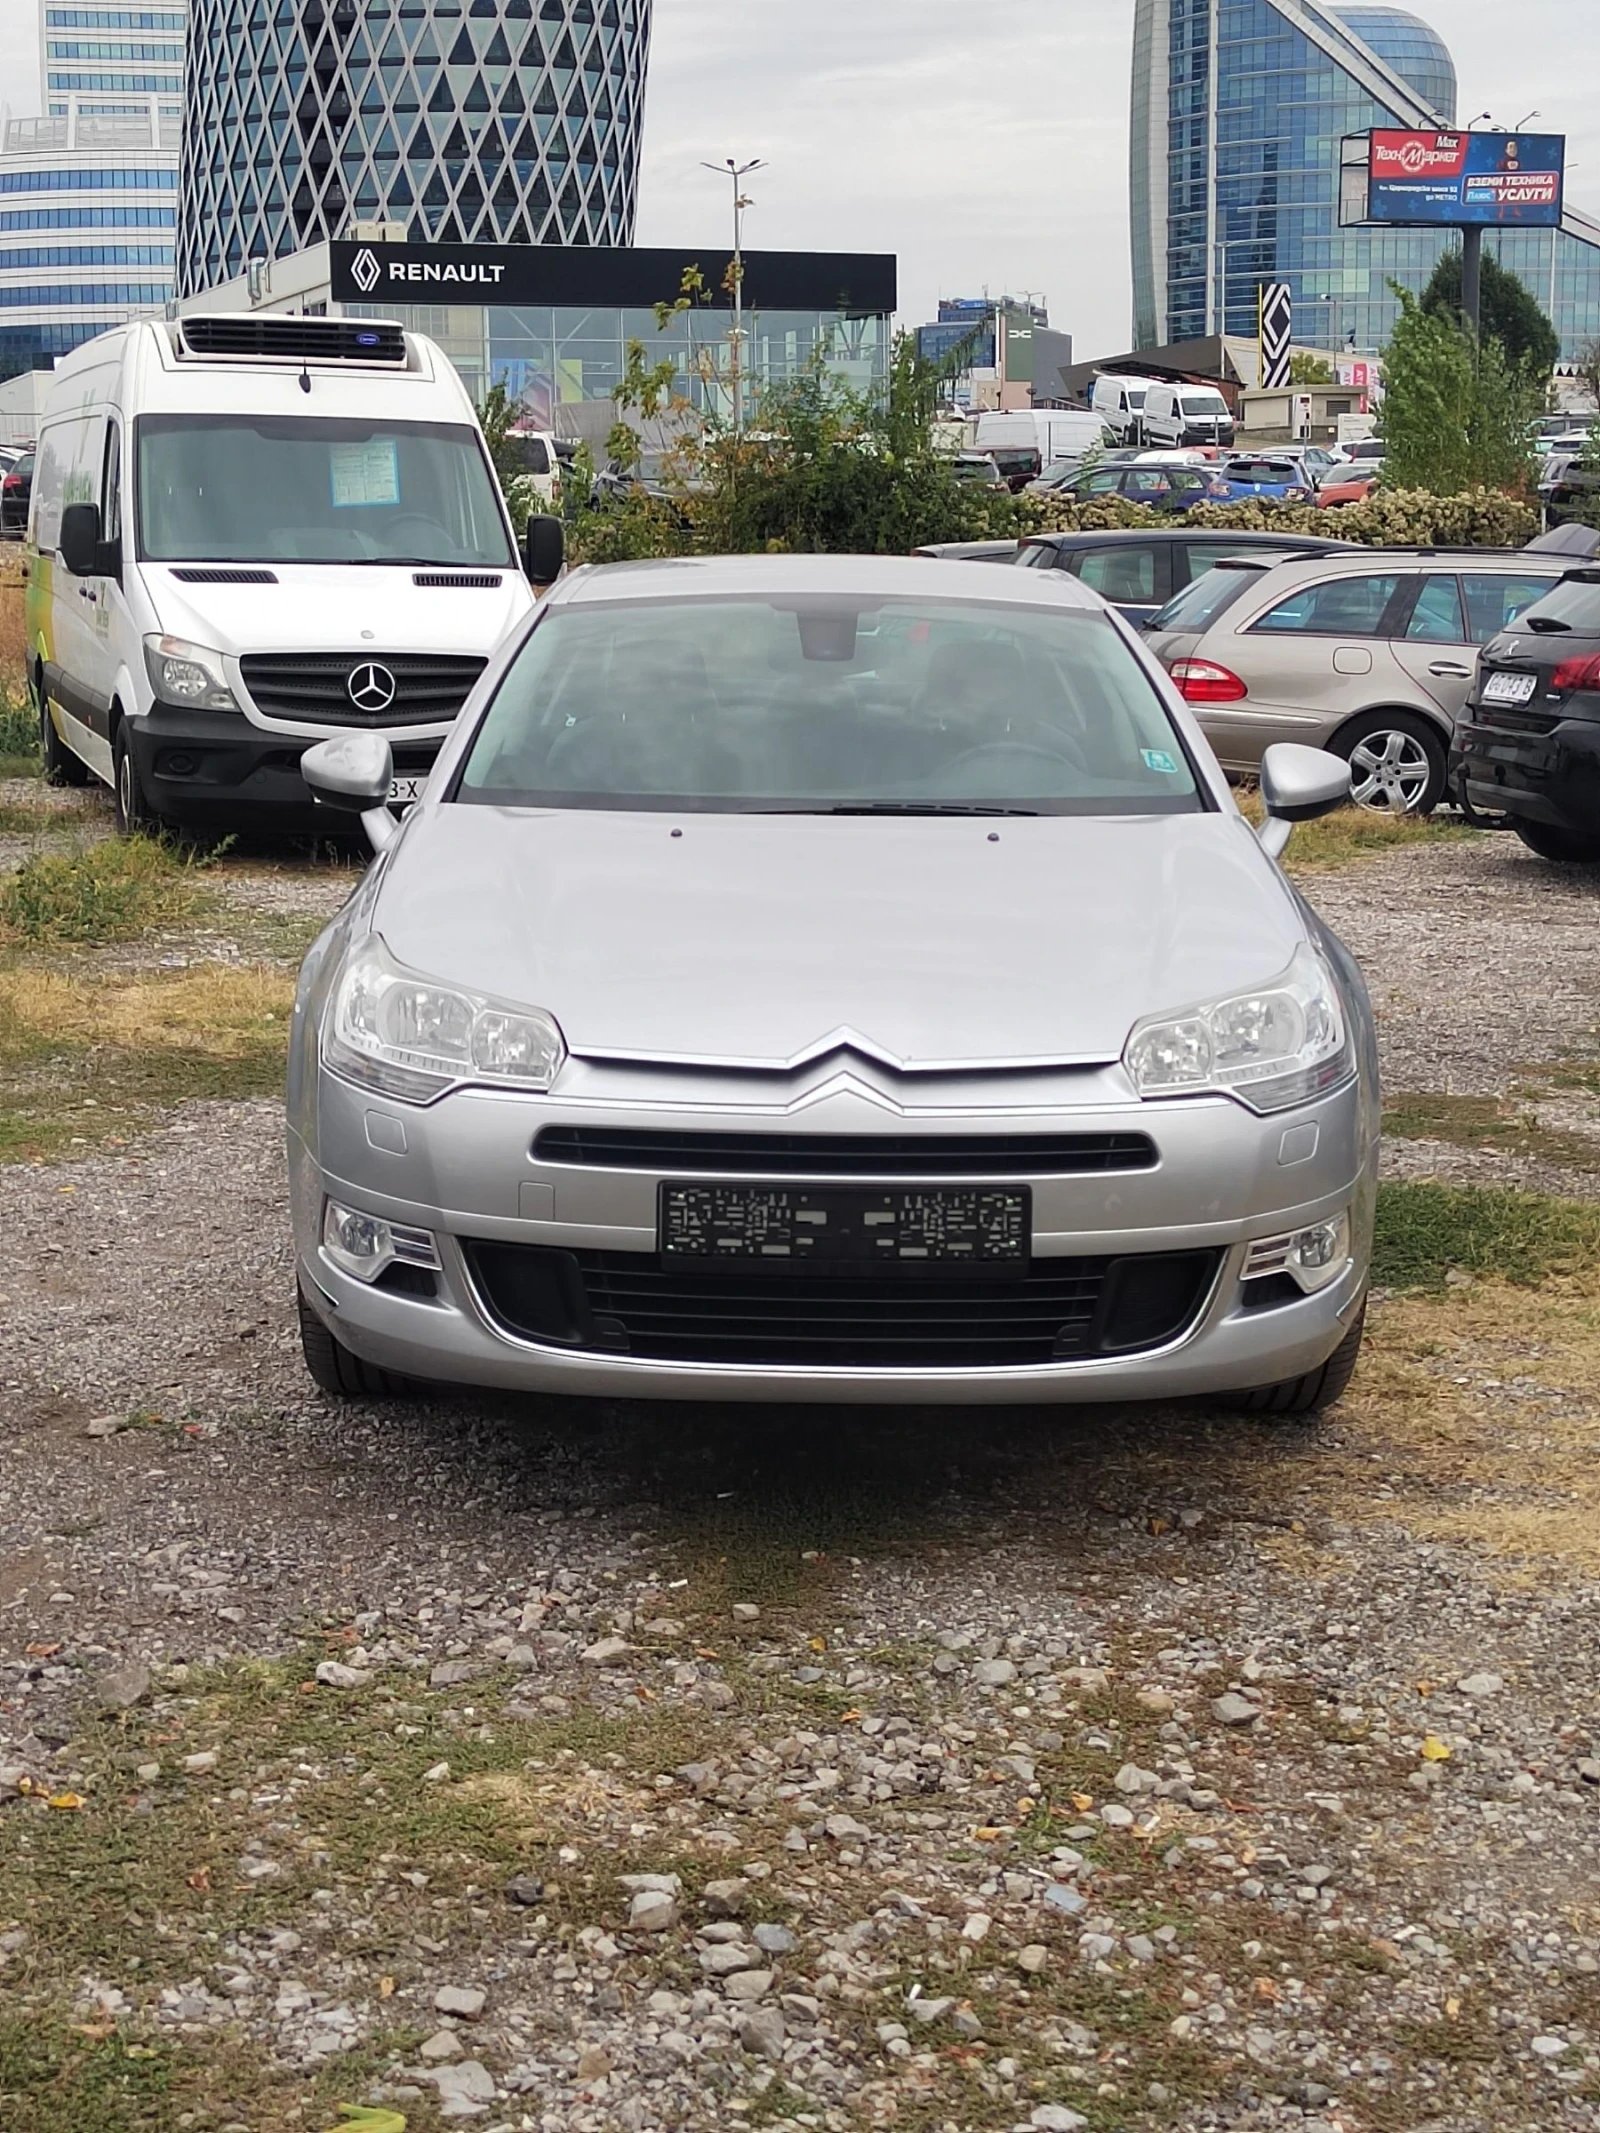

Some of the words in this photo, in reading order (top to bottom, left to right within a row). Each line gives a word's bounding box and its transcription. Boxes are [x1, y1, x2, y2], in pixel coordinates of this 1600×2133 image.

[1506, 175, 1554, 186] ТЕХНИКА
[1498, 188, 1554, 201] УСЛУГИ
[388, 262, 505, 283] RENAULT
